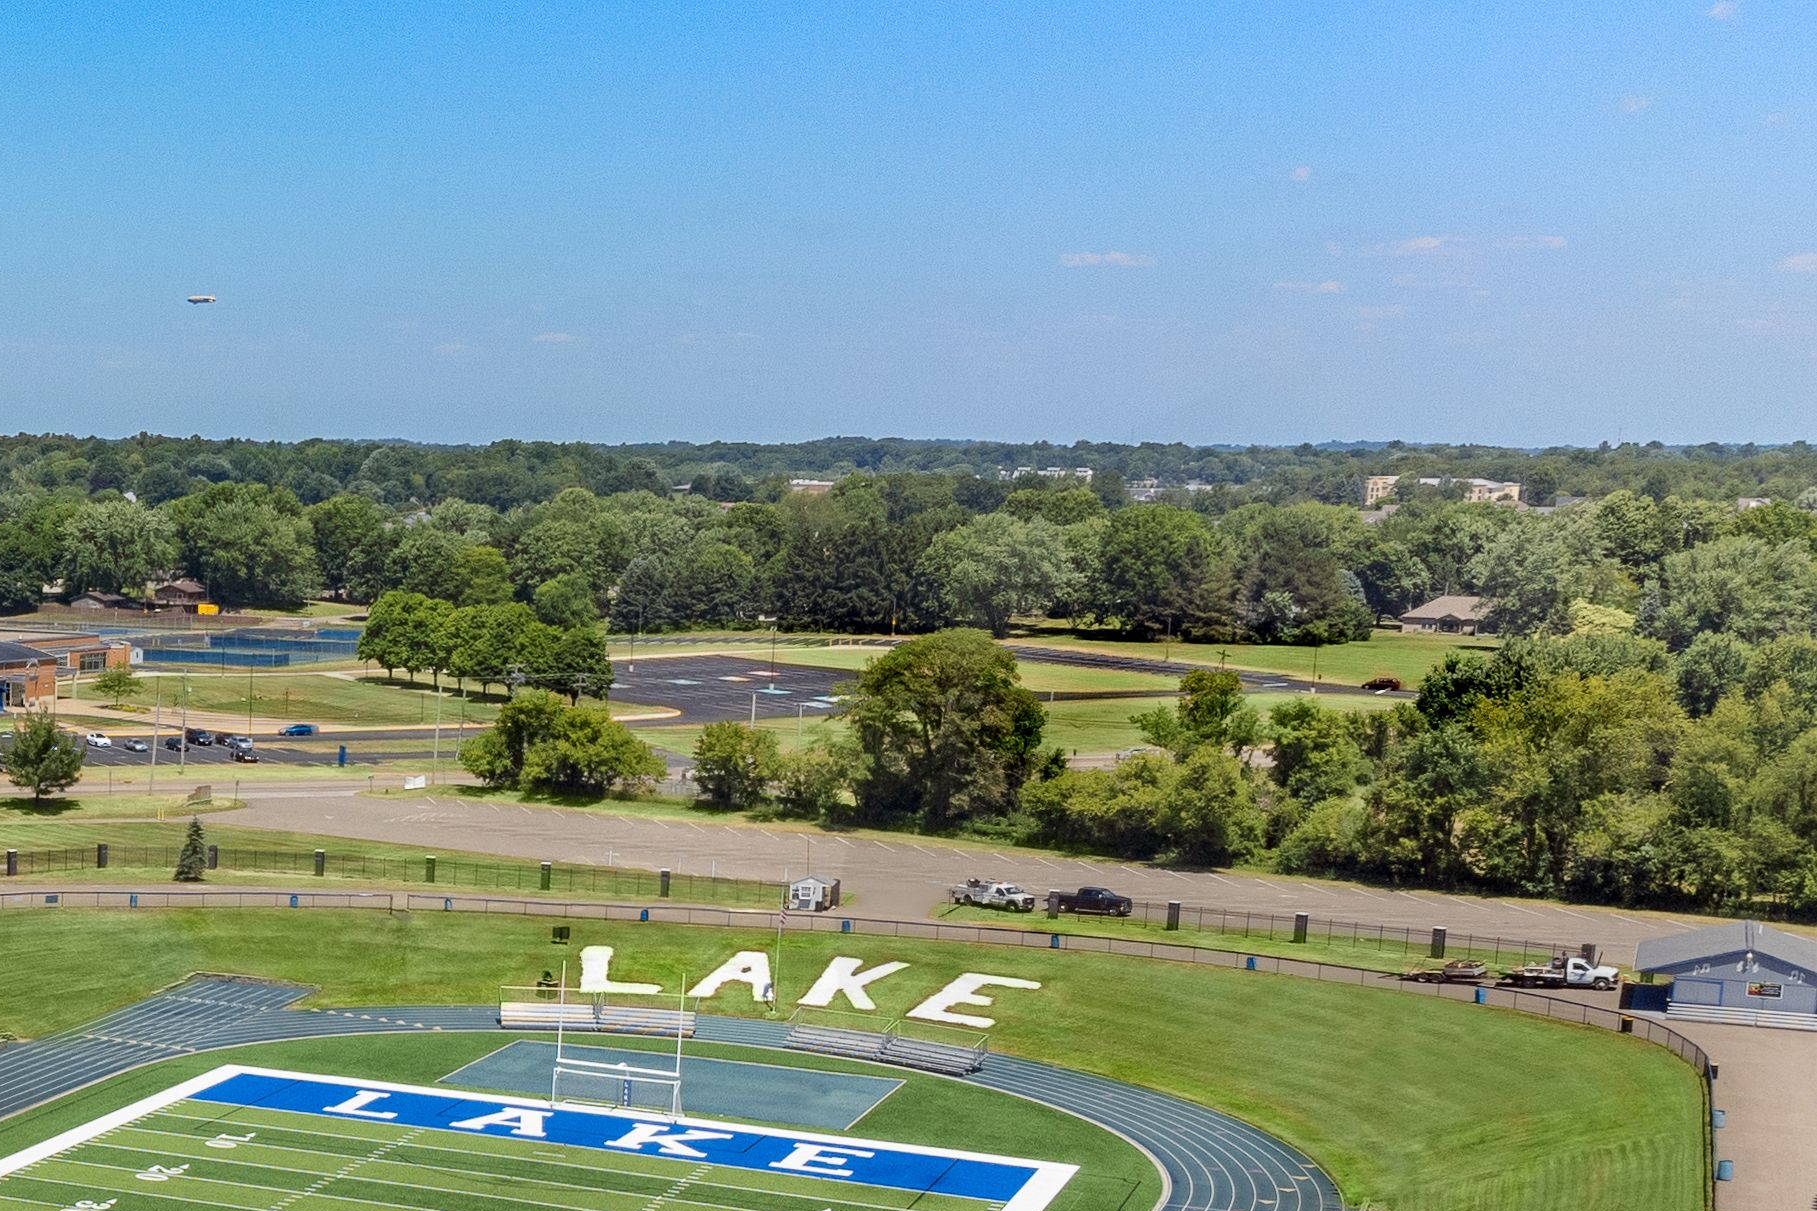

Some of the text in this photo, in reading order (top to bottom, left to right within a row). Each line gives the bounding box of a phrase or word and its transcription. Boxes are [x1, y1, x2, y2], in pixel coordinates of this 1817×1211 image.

[579, 945, 1041, 1028] LAKE
[204, 1132, 253, 1149] 10
[322, 1090, 875, 1178] LAKE
[135, 1164, 185, 1182] 20
